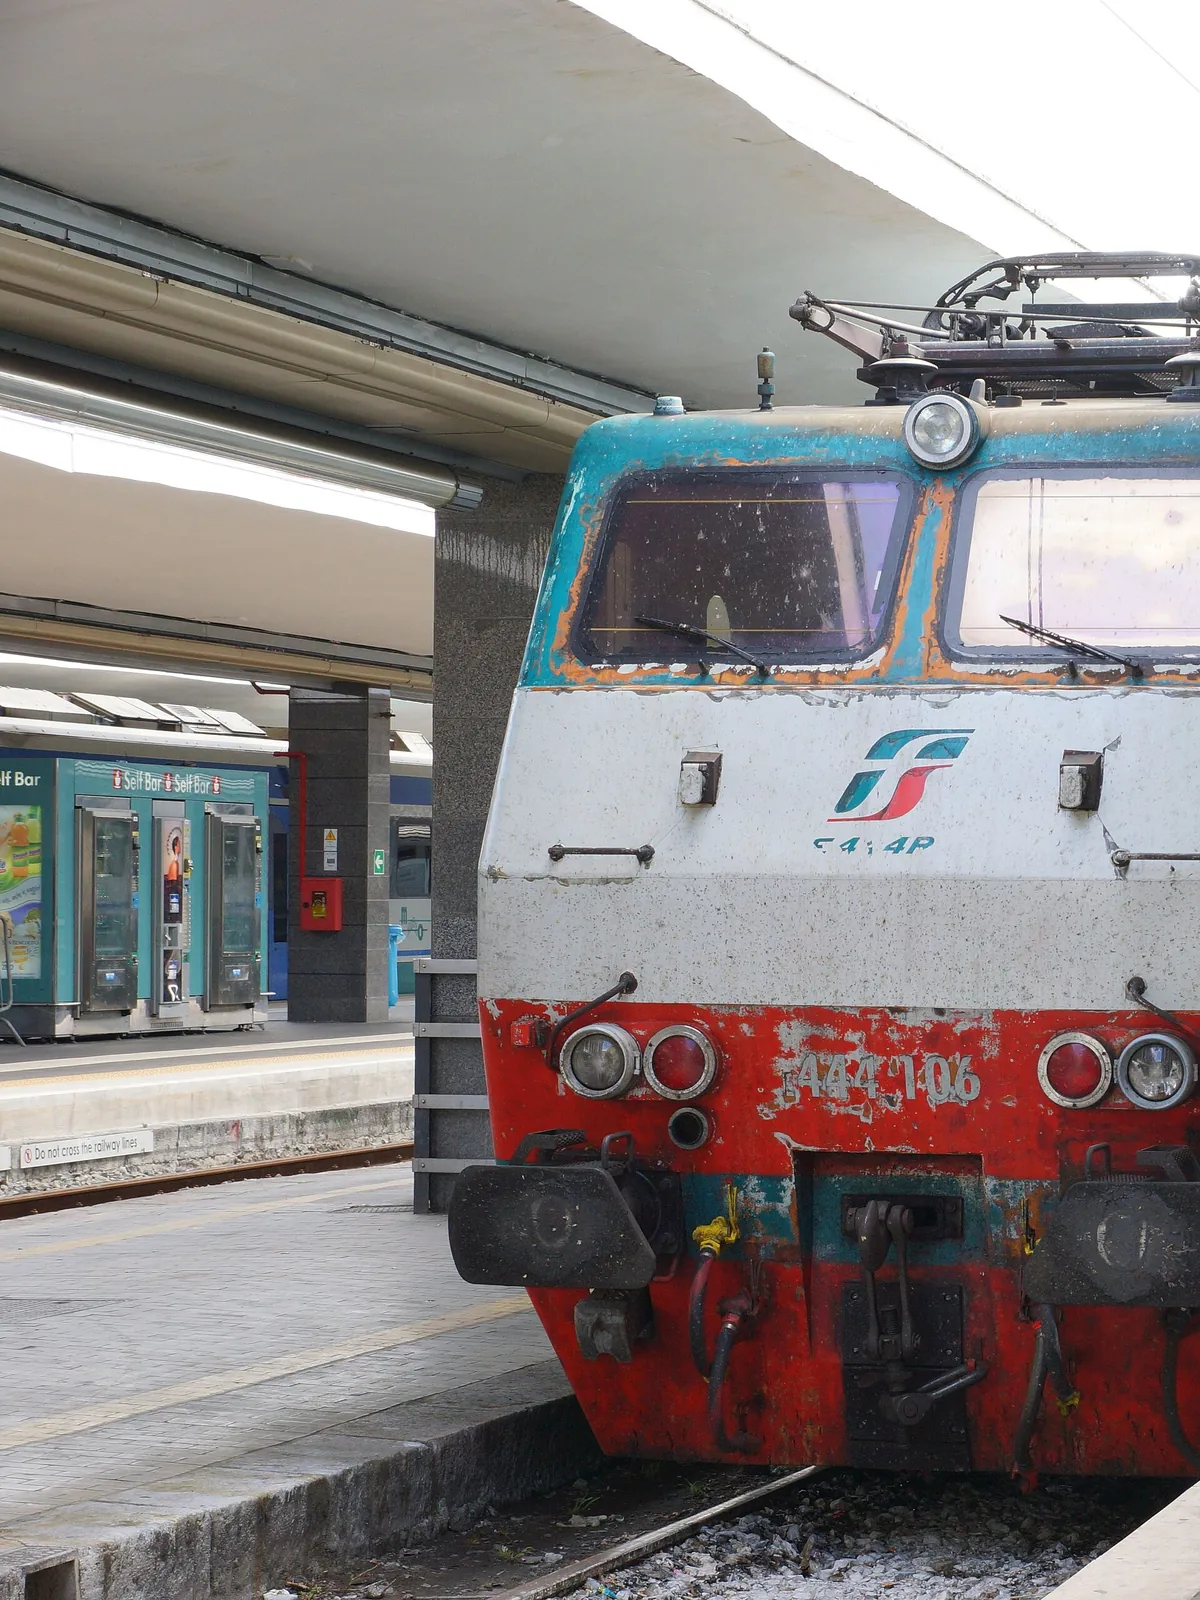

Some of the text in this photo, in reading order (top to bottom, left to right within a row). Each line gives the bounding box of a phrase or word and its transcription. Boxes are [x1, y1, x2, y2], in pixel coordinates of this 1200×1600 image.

[0, 770, 41, 786] lf Bar
[124, 770, 162, 792] Self Bar
[174, 773, 210, 794] Self Bar
[799, 1052, 880, 1100] 444
[900, 1053, 981, 1100] 106
[35, 1136, 138, 1160] Do not cross the railway lines
